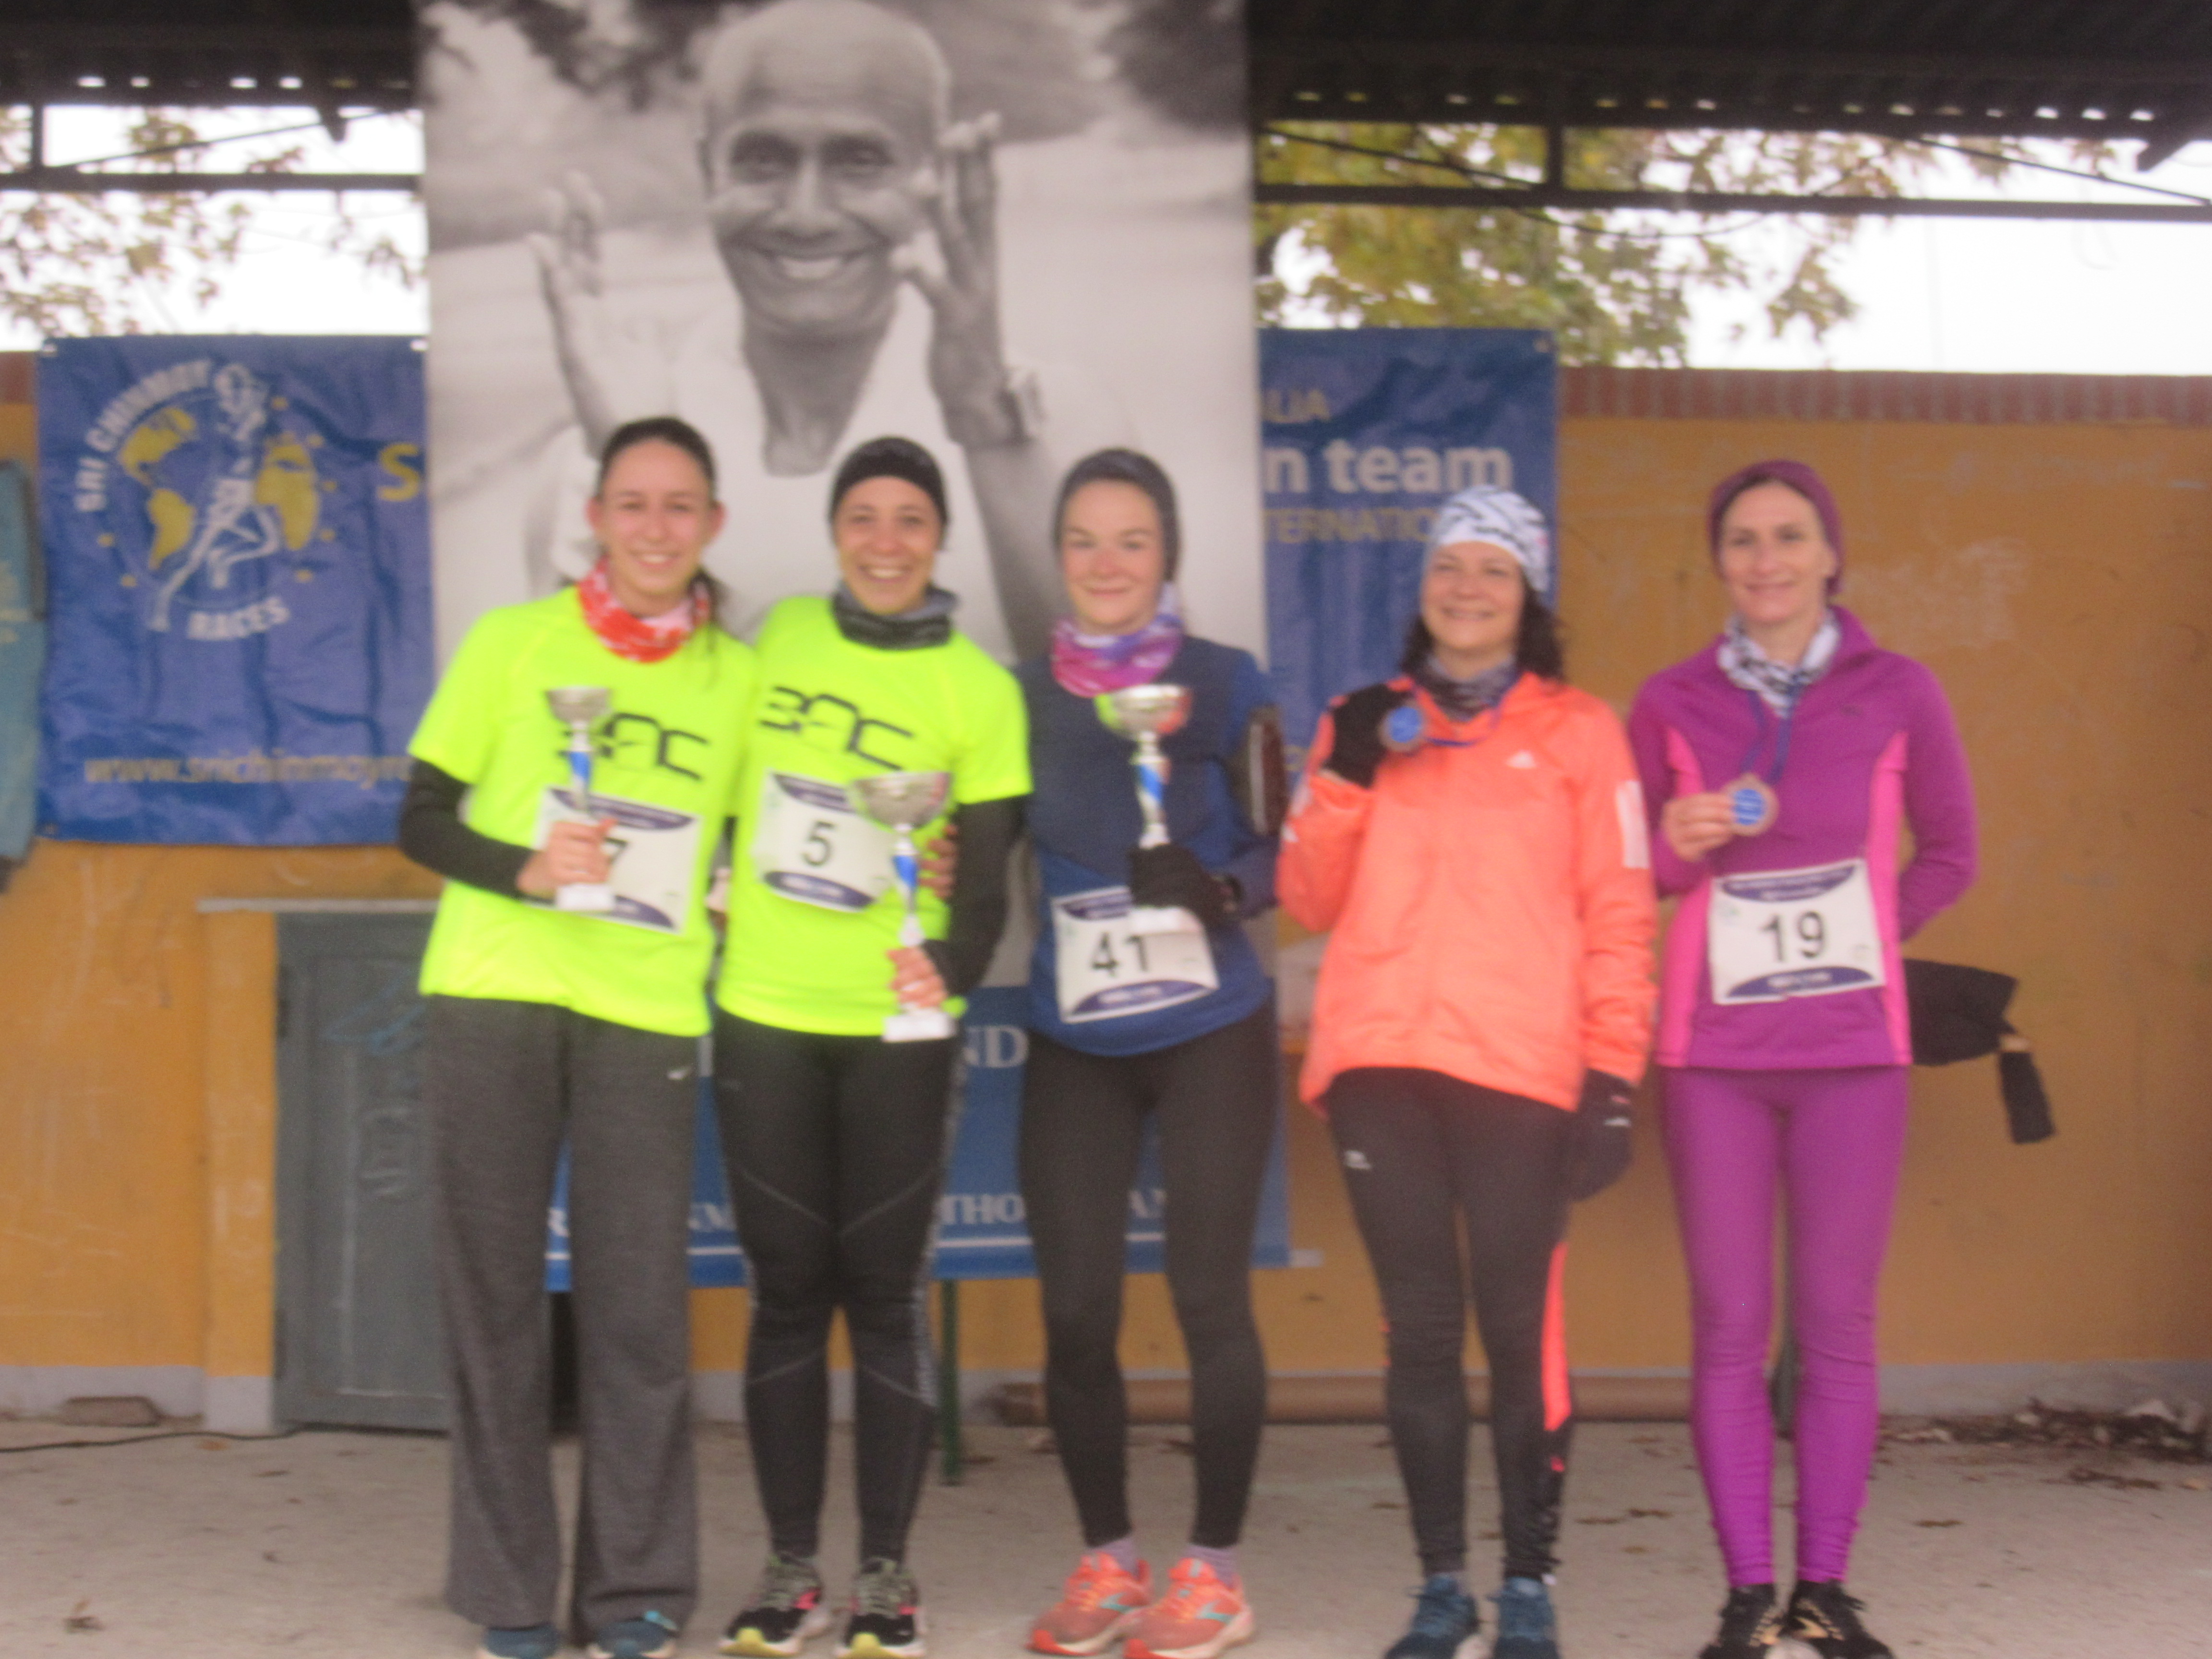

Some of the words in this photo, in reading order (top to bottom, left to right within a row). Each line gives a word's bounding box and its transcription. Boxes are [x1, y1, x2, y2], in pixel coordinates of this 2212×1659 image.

[1323, 437, 1514, 494] team
[801, 819, 836, 867] 5
[1090, 932, 1149, 977] 41
[1760, 910, 1827, 963] 19
